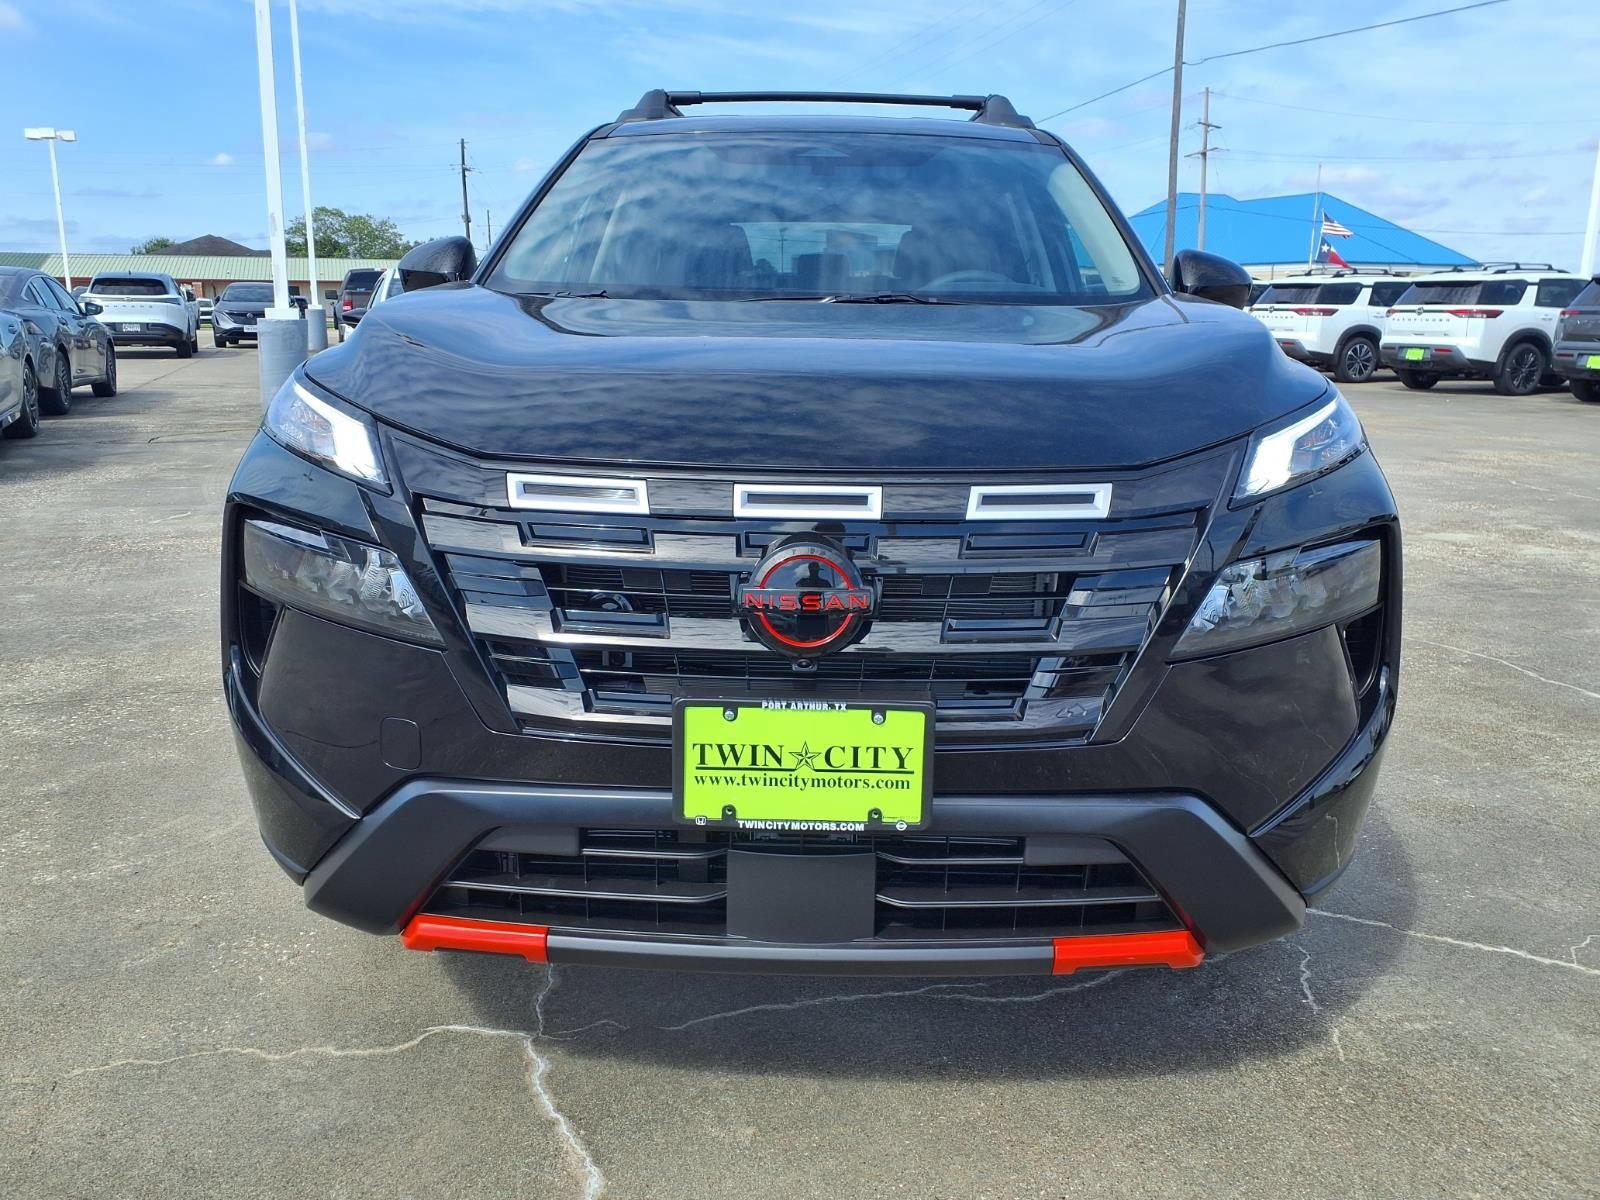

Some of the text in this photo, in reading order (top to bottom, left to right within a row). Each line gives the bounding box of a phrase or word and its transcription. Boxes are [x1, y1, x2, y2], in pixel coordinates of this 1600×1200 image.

[744, 592, 868, 611] NISSAN
[761, 700, 787, 710] PORT
[834, 703, 847, 711] TX
[692, 743, 914, 770] TWIN CITY
[694, 772, 911, 791] www.twincitymotors.com
[738, 820, 865, 832] TWINCITYMOTORS.COM
